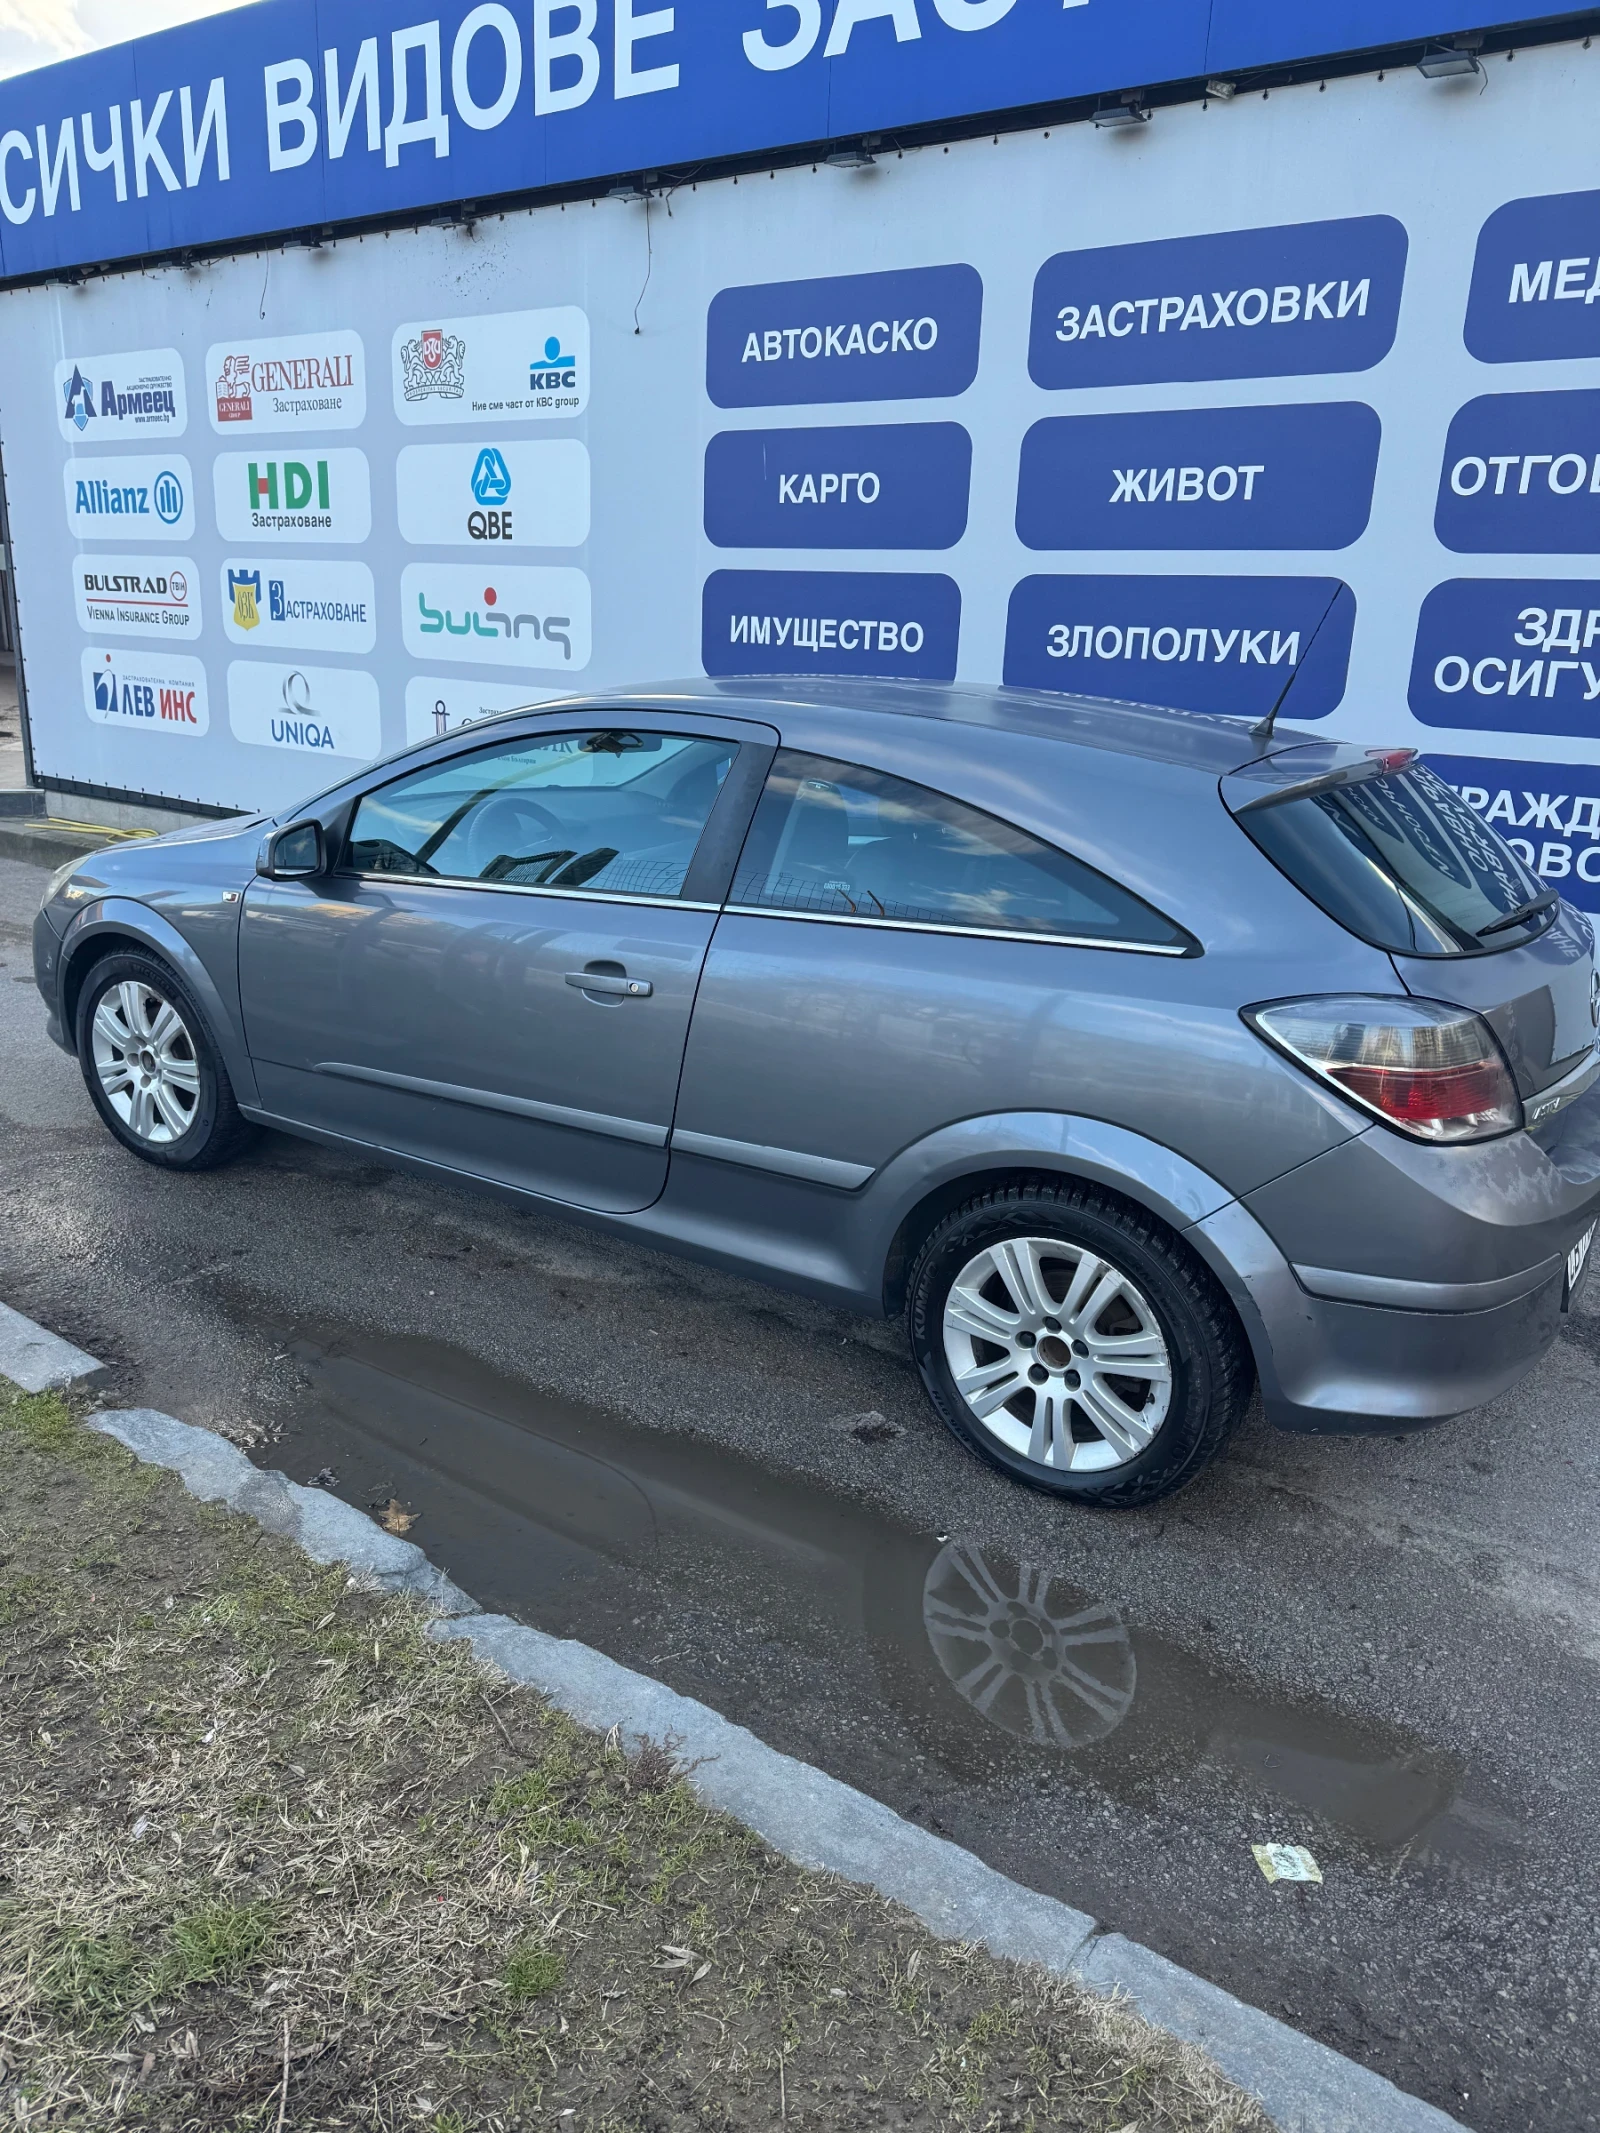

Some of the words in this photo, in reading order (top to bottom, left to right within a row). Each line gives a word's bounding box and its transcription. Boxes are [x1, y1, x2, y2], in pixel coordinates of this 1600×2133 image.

[264, 0, 681, 172] ВИДОВЕ
[1056, 279, 1370, 341] ЗАСТРАХОВКИ
[742, 317, 938, 363] АВТОКАСКО
[251, 354, 354, 392] GENERALI
[530, 370, 575, 390] KBC
[101, 380, 176, 420] Армеец
[273, 397, 342, 415] Застраховане
[472, 402, 487, 411] Ние
[488, 401, 503, 410] сме
[505, 400, 524, 410] част
[525, 400, 534, 408] от
[536, 397, 553, 407] KBC
[555, 398, 579, 409] group
[248, 460, 330, 510] HDI
[779, 472, 880, 503] КАРГО
[1109, 465, 1264, 502] ЖИВОТ
[1451, 453, 1600, 496] ОТГО
[76, 480, 150, 514] Allianz
[252, 512, 332, 531] Застраховане
[468, 511, 512, 540] QBE
[84, 574, 167, 594] BULSTRAD
[730, 615, 924, 653] ИМУЩЕСТВО
[1046, 625, 1300, 665] ЗЛОПОЛУКИ
[122, 682, 155, 718] ЛЕВ
[160, 688, 197, 724] ИНС
[271, 719, 334, 749] UNIQA
[914, 1261, 939, 1341] KUMHO
